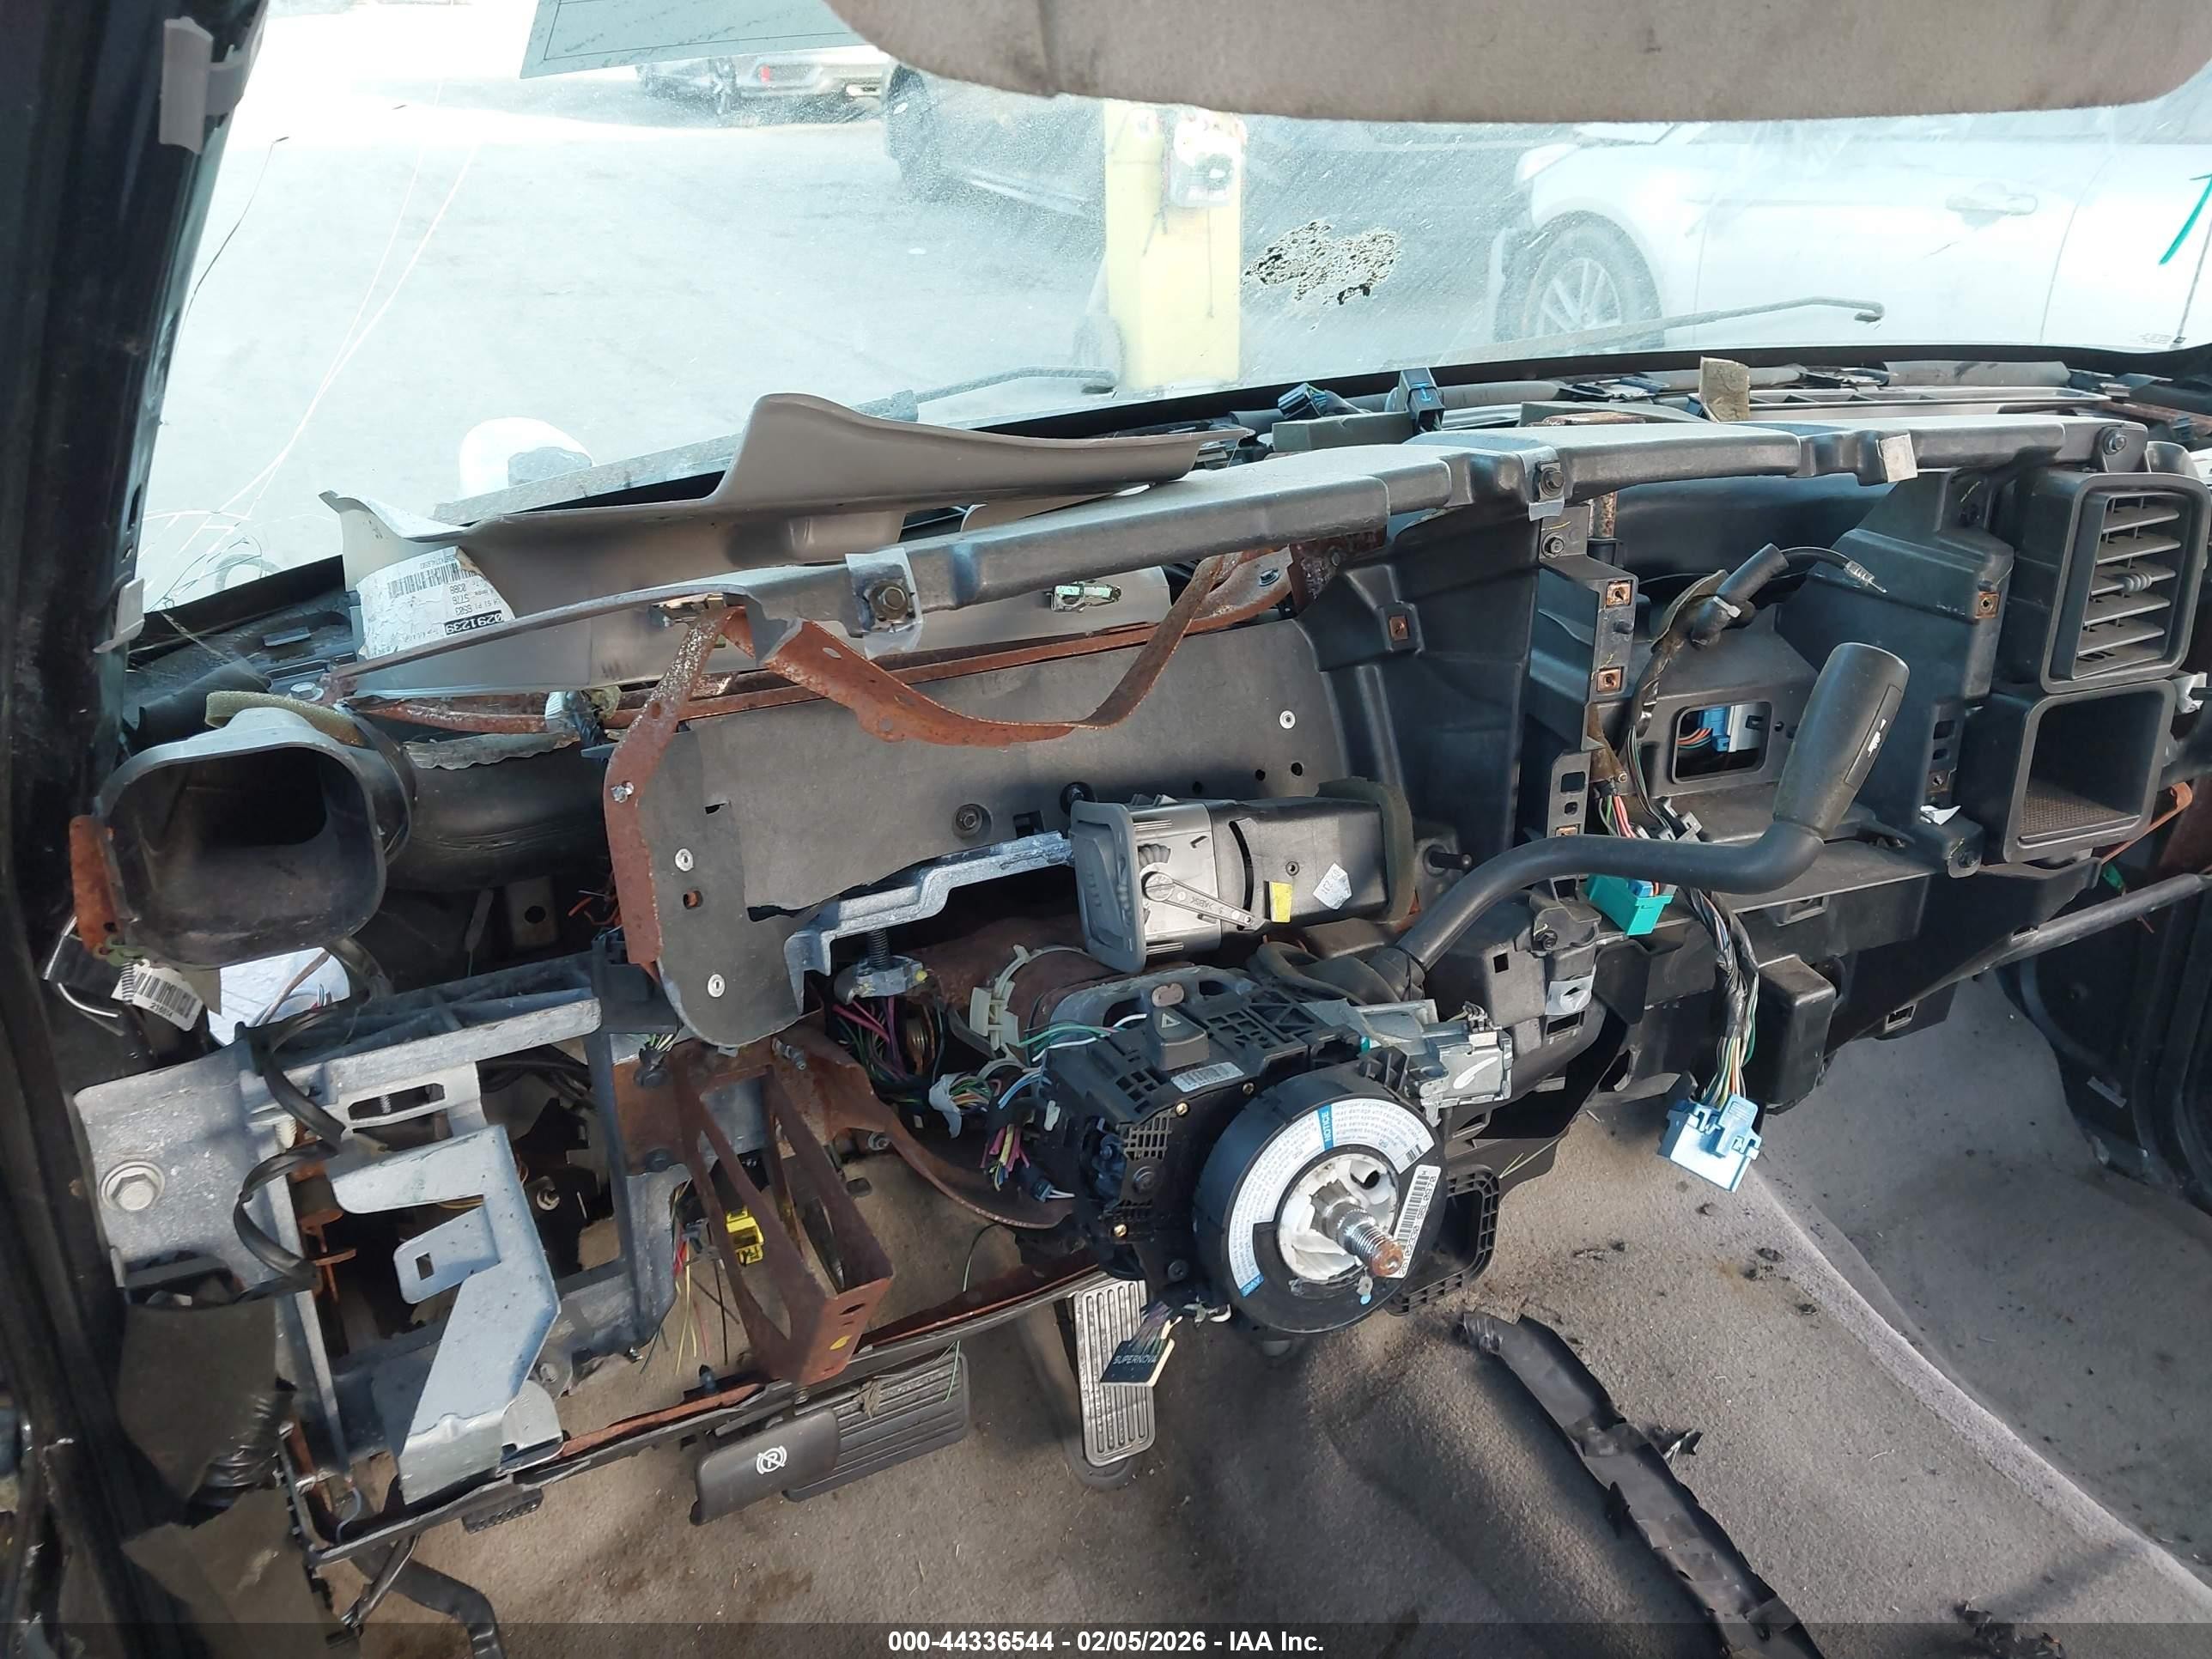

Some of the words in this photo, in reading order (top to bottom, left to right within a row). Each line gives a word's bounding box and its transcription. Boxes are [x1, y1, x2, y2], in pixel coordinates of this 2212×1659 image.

[452, 593, 470, 605] 5776
[445, 612, 502, 635] 0291239
[1322, 1111, 1330, 1142] NOTICE
[1113, 1354, 1157, 1365] SUPERNOVA
